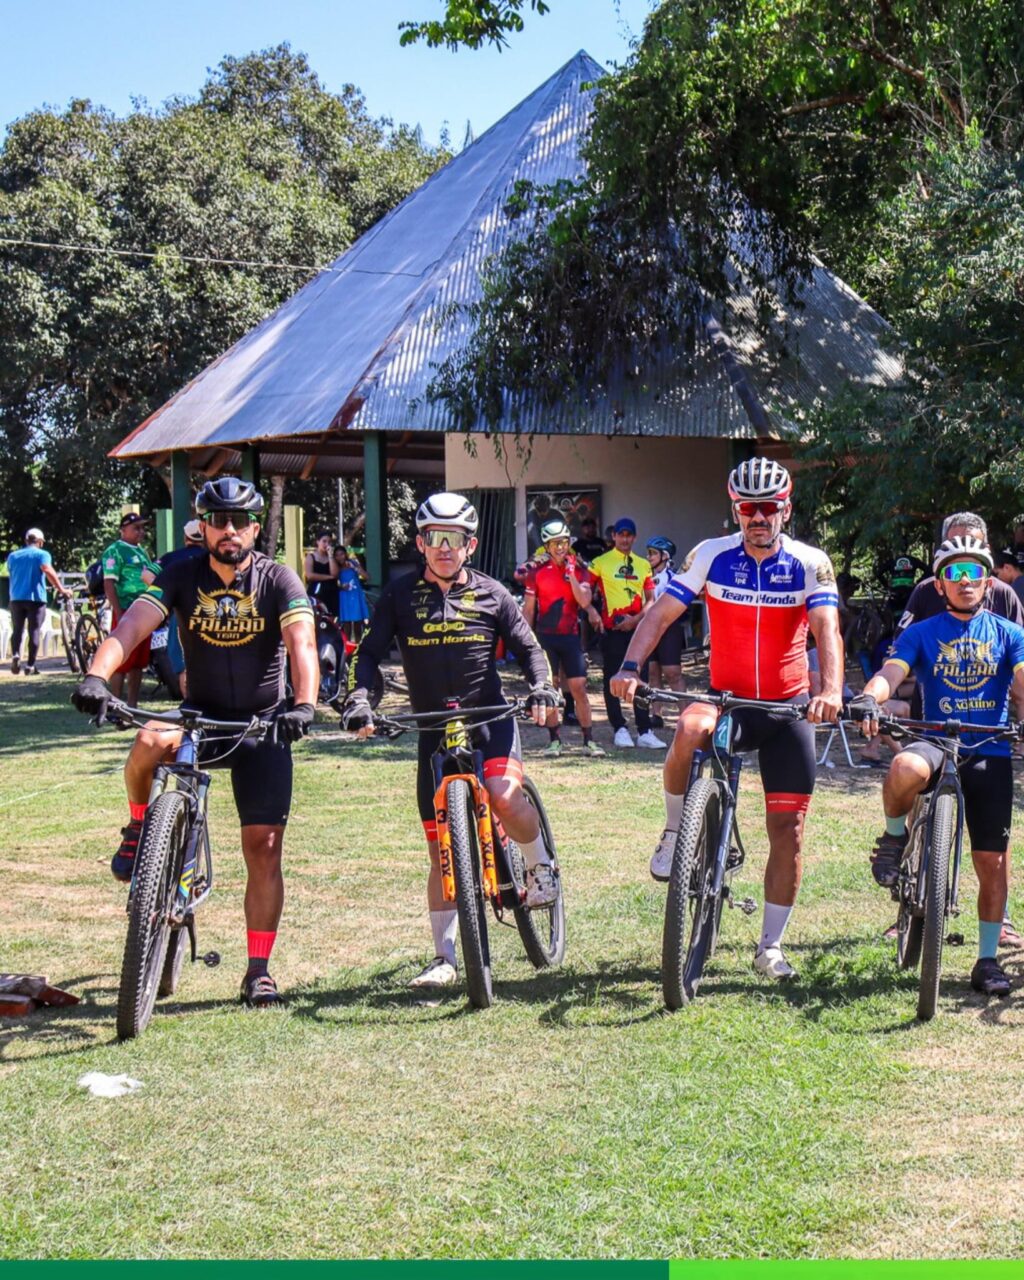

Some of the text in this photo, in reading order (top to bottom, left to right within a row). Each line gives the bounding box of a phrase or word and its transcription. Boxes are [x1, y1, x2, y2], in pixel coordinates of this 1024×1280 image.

[720, 588, 753, 603] Team
[756, 593, 797, 605] Honda
[406, 634, 486, 647] Team Honda
